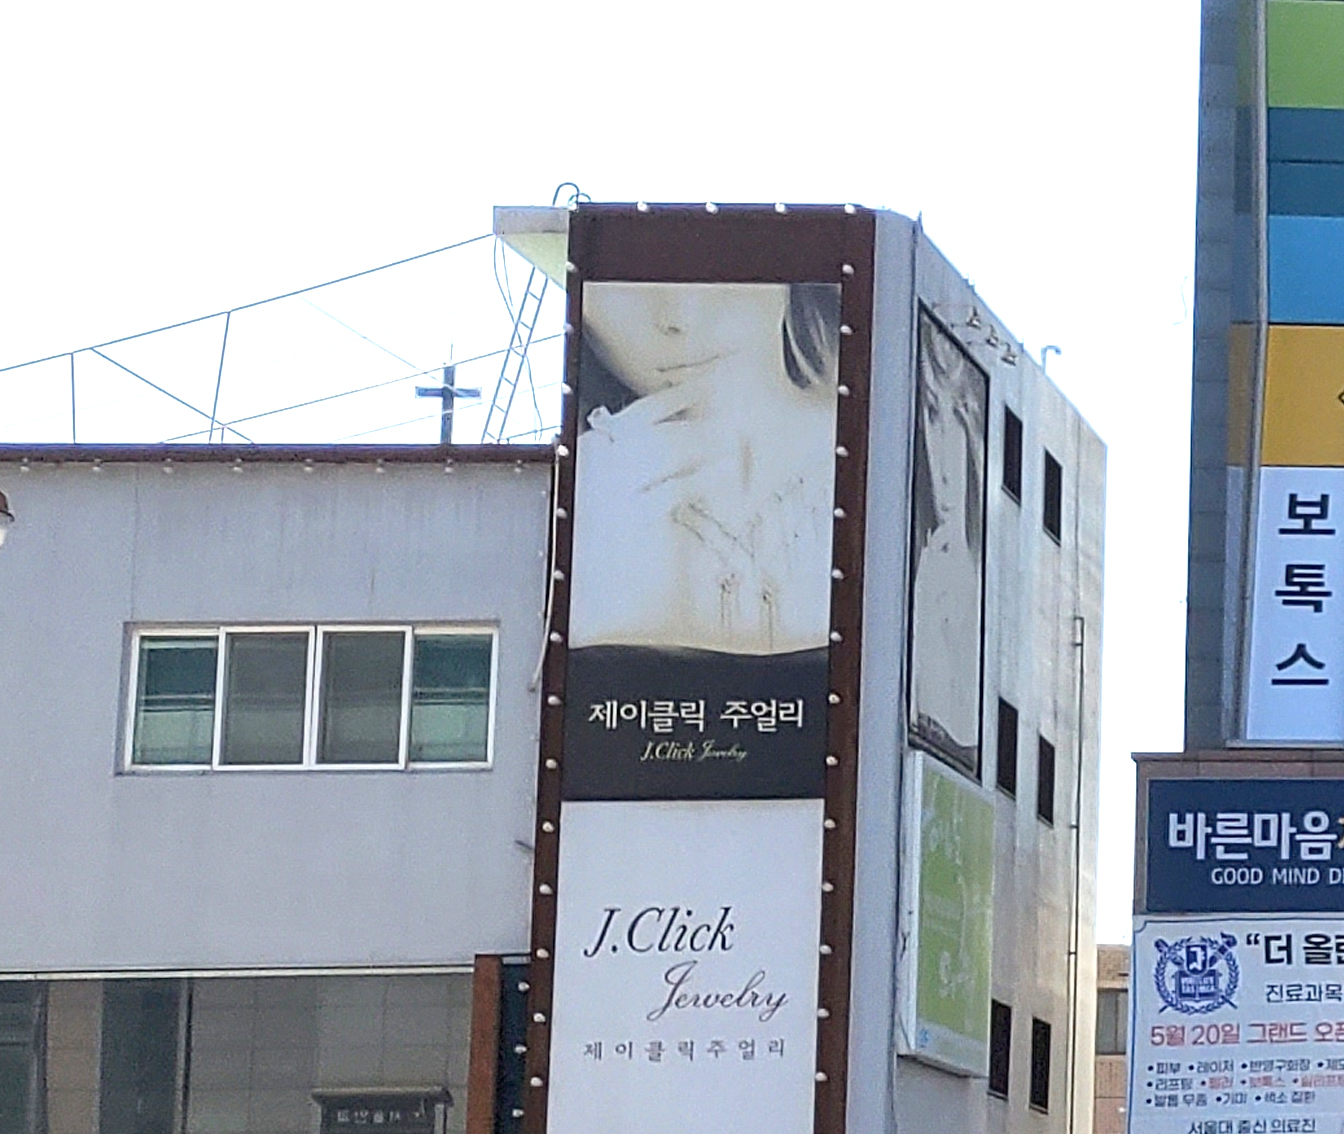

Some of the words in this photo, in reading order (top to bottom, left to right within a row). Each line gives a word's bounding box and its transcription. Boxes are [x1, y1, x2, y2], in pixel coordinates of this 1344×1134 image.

[1270, 493, 1338, 690] 보톡스
[588, 699, 706, 732] 제이클릭
[720, 698, 805, 729] 주얼리
[640, 742, 696, 762] J.Click
[1211, 866, 1264, 885] GOOD
[1272, 866, 1320, 885] MIND
[583, 906, 735, 959] J.Click
[648, 960, 789, 1022] Jewelry
[1265, 982, 1344, 1003] 진료과목
[1150, 1027, 1187, 1048] 5월
[1190, 1024, 1241, 1046] 20일
[1247, 1022, 1309, 1044] 그랜드
[1197, 1060, 1235, 1073] 레이저
[1188, 1119, 1234, 1134] 서울대
[1270, 1117, 1316, 1134] 의료진
